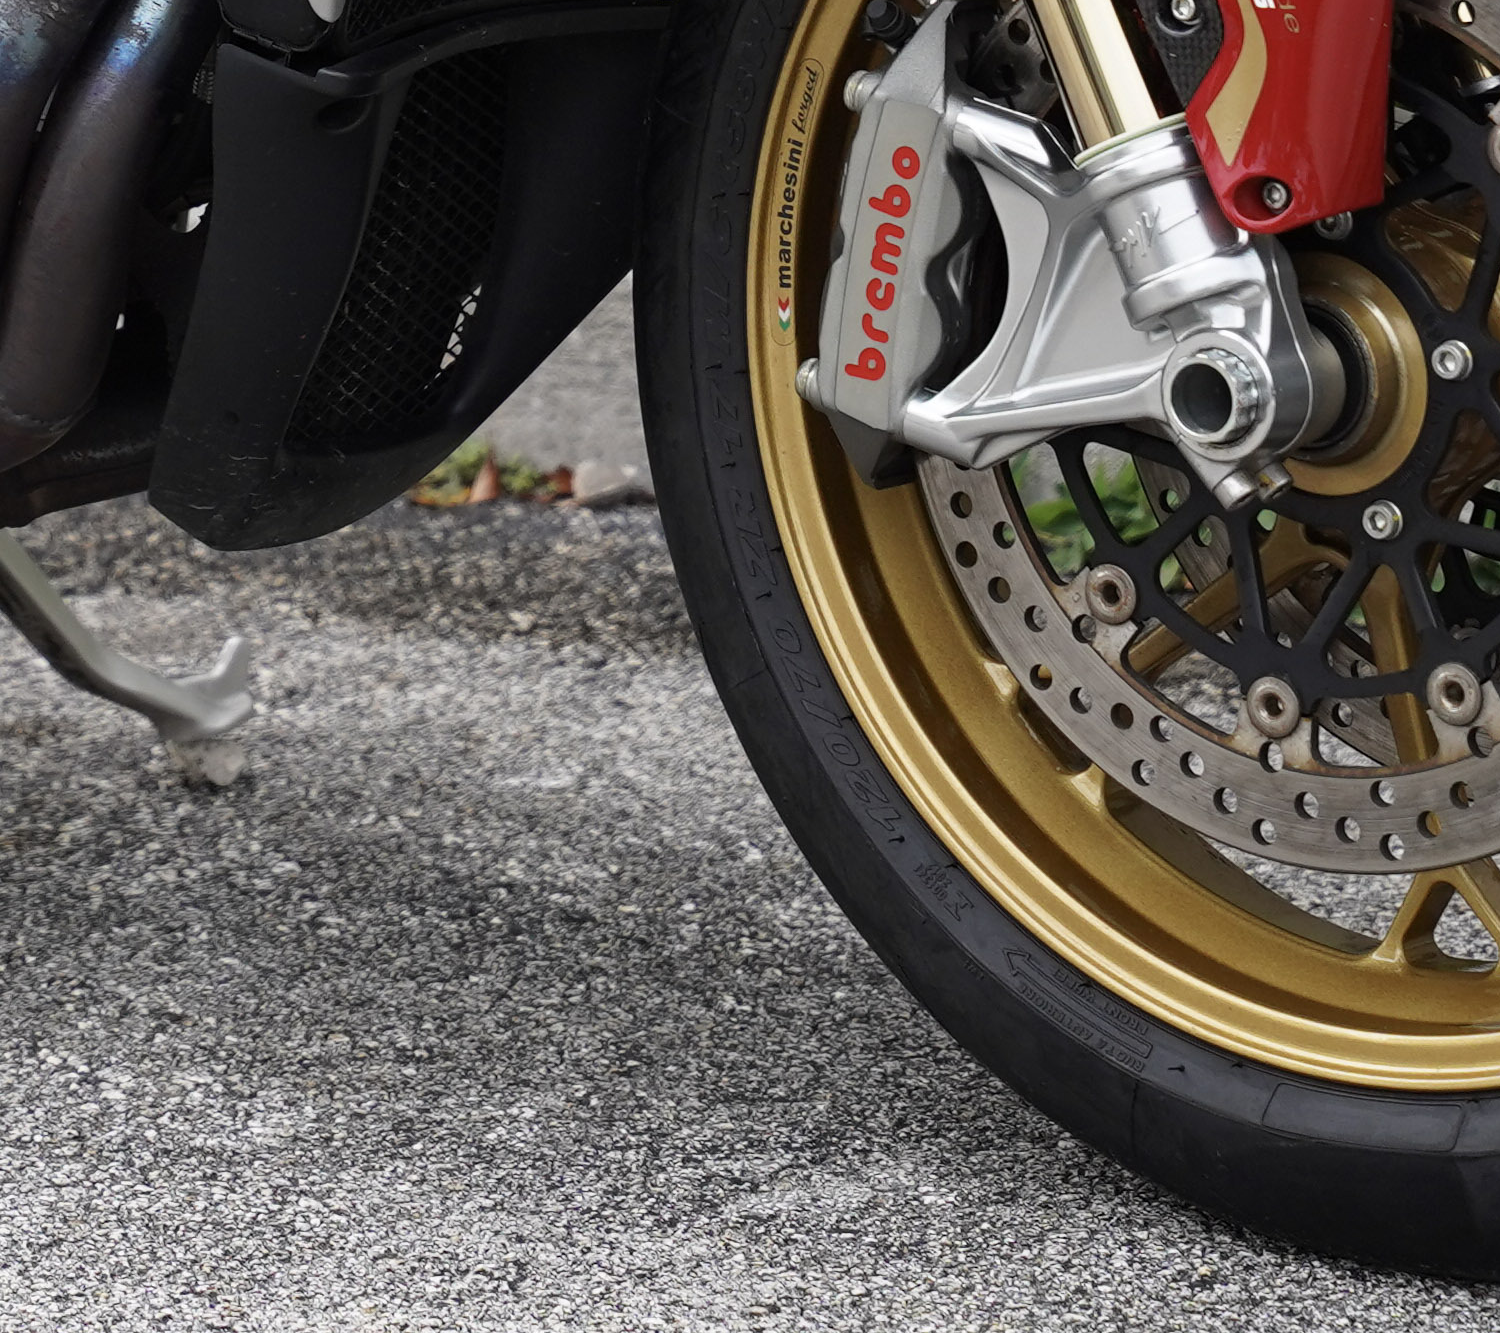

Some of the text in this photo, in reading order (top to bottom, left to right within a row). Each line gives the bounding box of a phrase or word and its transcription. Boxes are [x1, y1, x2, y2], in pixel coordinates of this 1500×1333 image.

[776, 66, 818, 290] marchesini forged
[844, 144, 921, 382] brembo
[774, 619, 904, 835] 120/70
